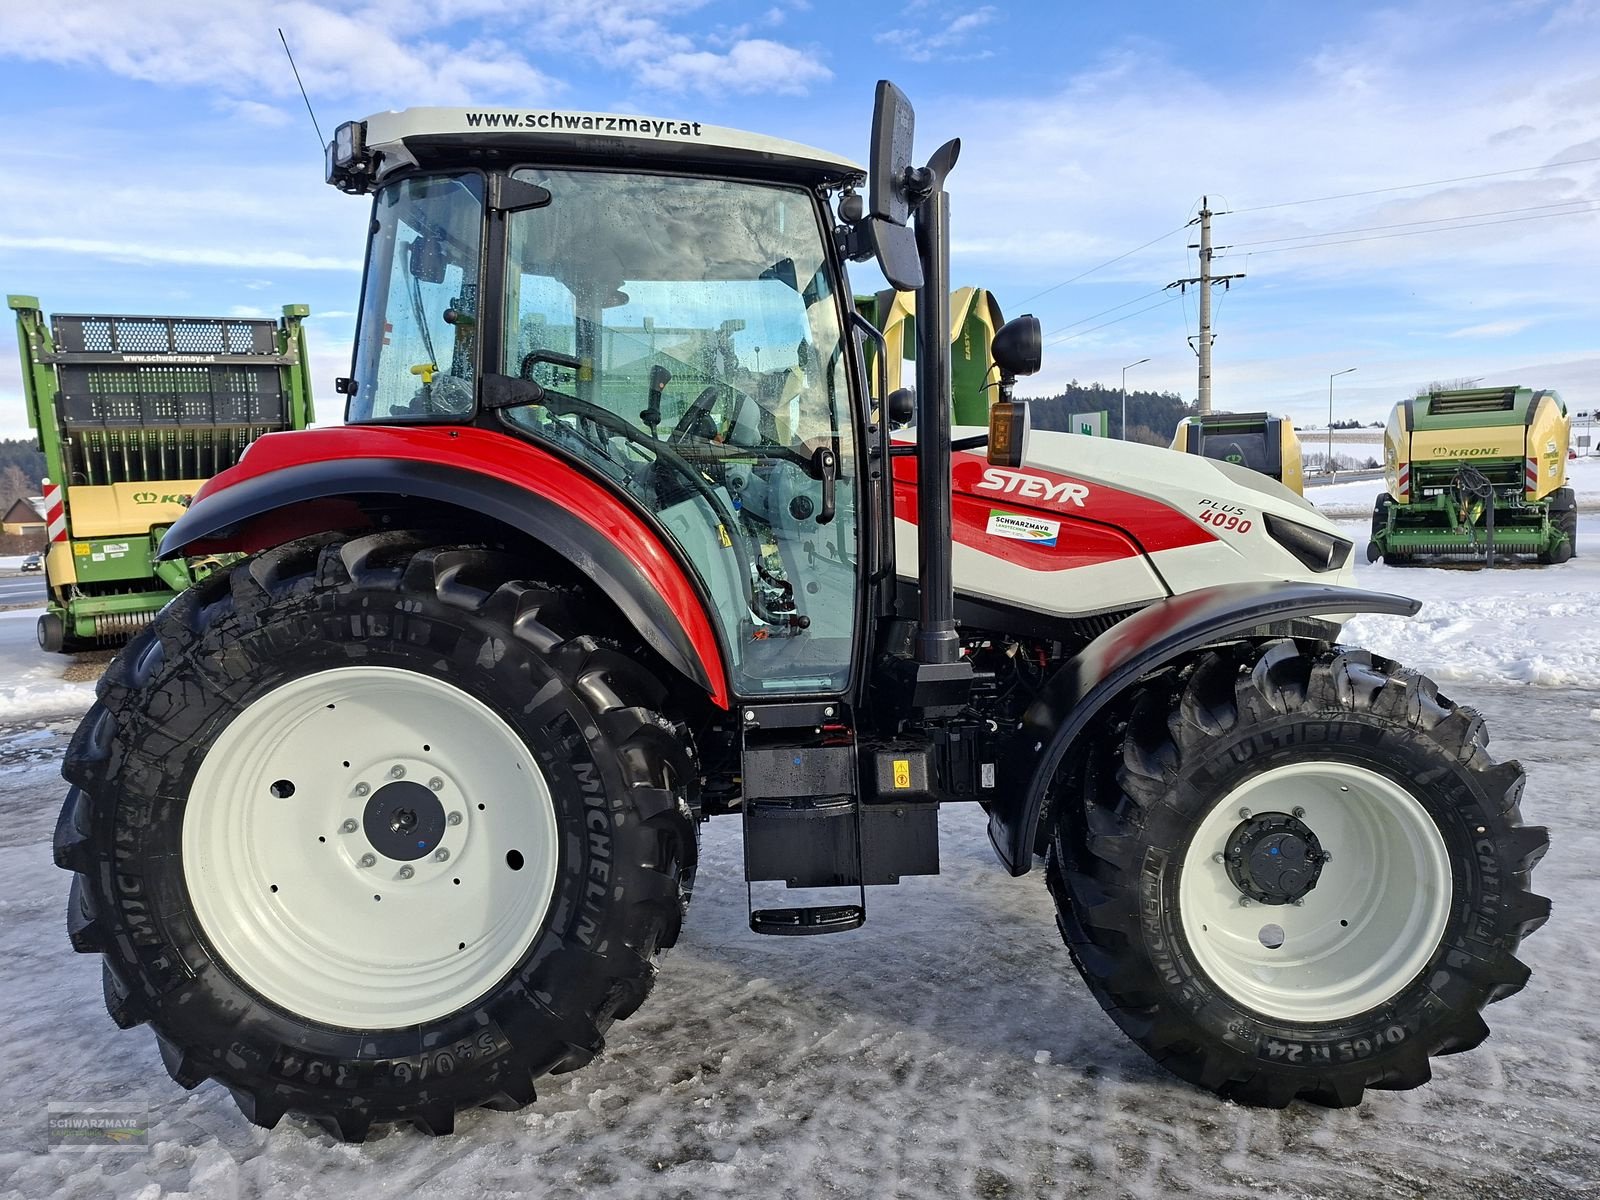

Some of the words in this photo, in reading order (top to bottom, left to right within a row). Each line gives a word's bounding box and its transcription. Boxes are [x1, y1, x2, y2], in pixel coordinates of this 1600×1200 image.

[465, 112, 702, 138] www.schwarzmayr.at
[122, 353, 216, 364] www.schwarzmayr.at
[1449, 447, 1500, 457] KRONE
[976, 468, 1090, 507] STEYR
[1198, 498, 1247, 516] PLUS
[995, 516, 1049, 532] SCHWARZMAYR
[1199, 509, 1252, 534] 4090
[571, 762, 611, 946] MICHELIN
